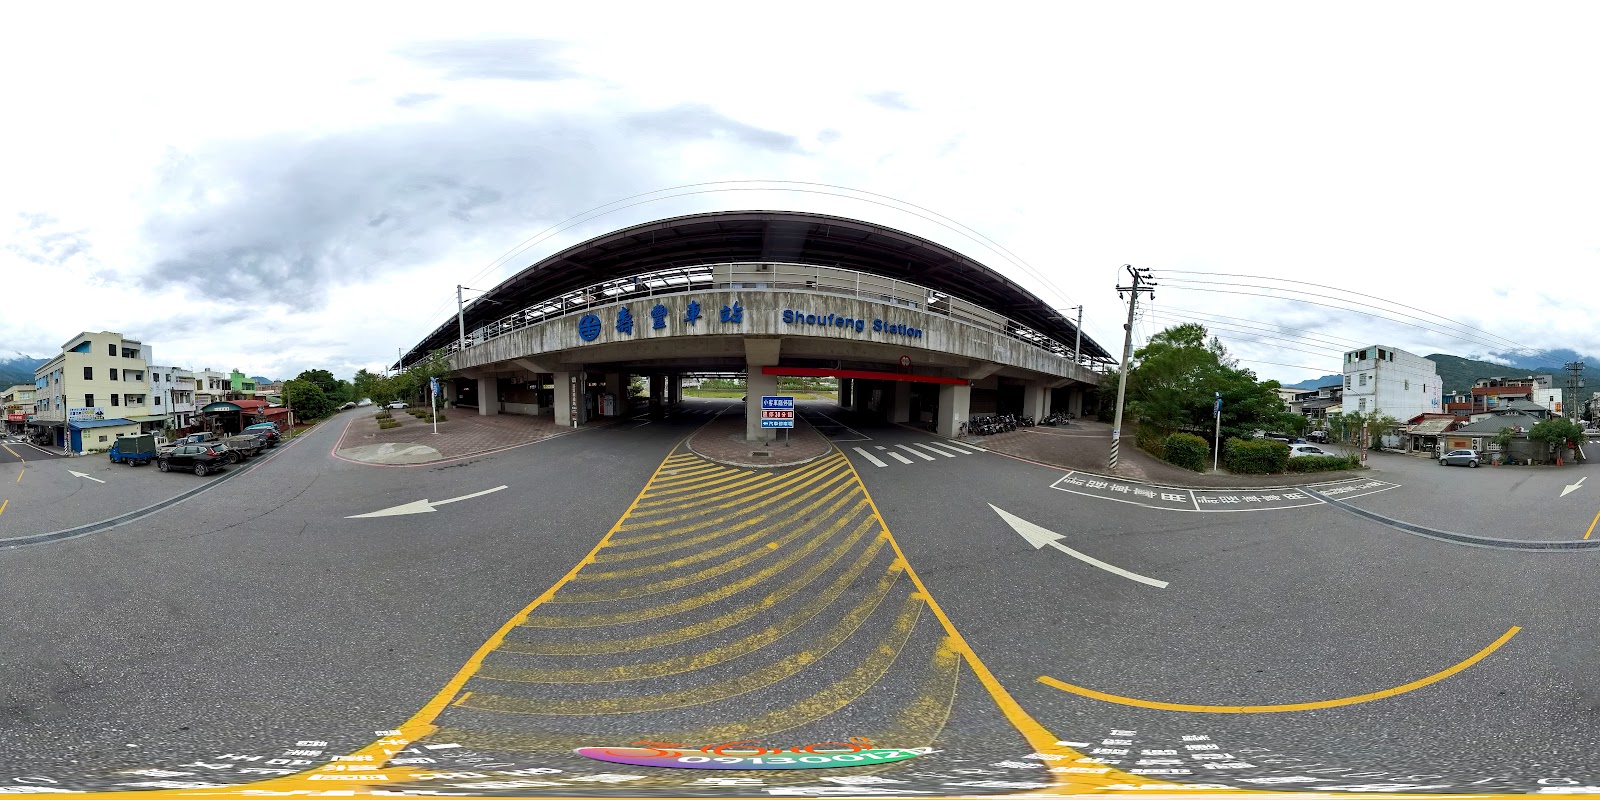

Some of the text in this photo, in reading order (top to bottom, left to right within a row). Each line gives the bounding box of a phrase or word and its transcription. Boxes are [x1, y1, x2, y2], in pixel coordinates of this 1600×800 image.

[616, 299, 743, 336] 壽豐車站
[782, 309, 923, 339] Shoufeng Station
